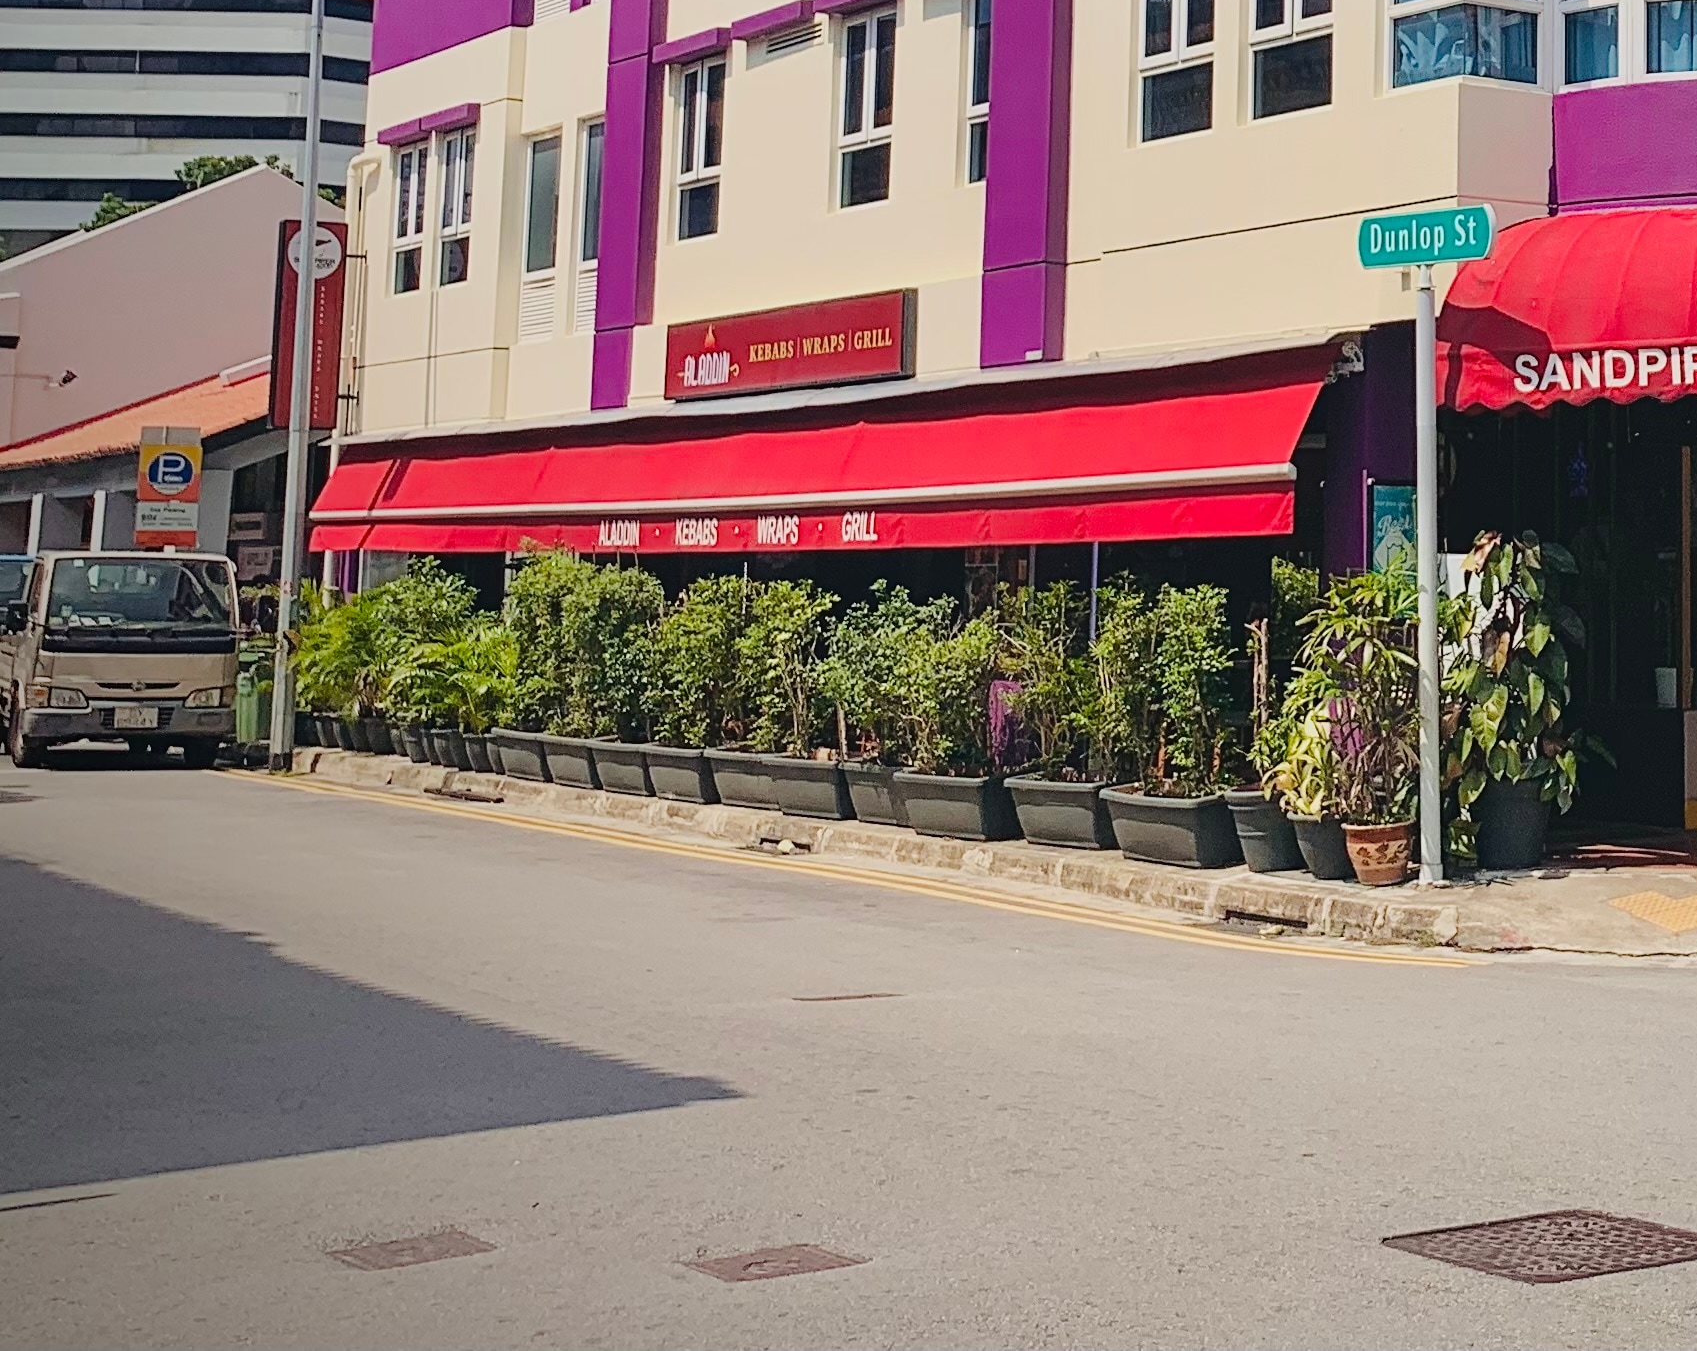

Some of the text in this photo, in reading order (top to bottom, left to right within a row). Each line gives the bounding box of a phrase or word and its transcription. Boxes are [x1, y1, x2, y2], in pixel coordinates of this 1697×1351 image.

[1370, 214, 1477, 256] Dunlop St
[683, 327, 893, 387] ALADDIN KEBABS WRAPS GRILL
[599, 511, 878, 547] ALADDIN KEBABS WRAPS GRILL
